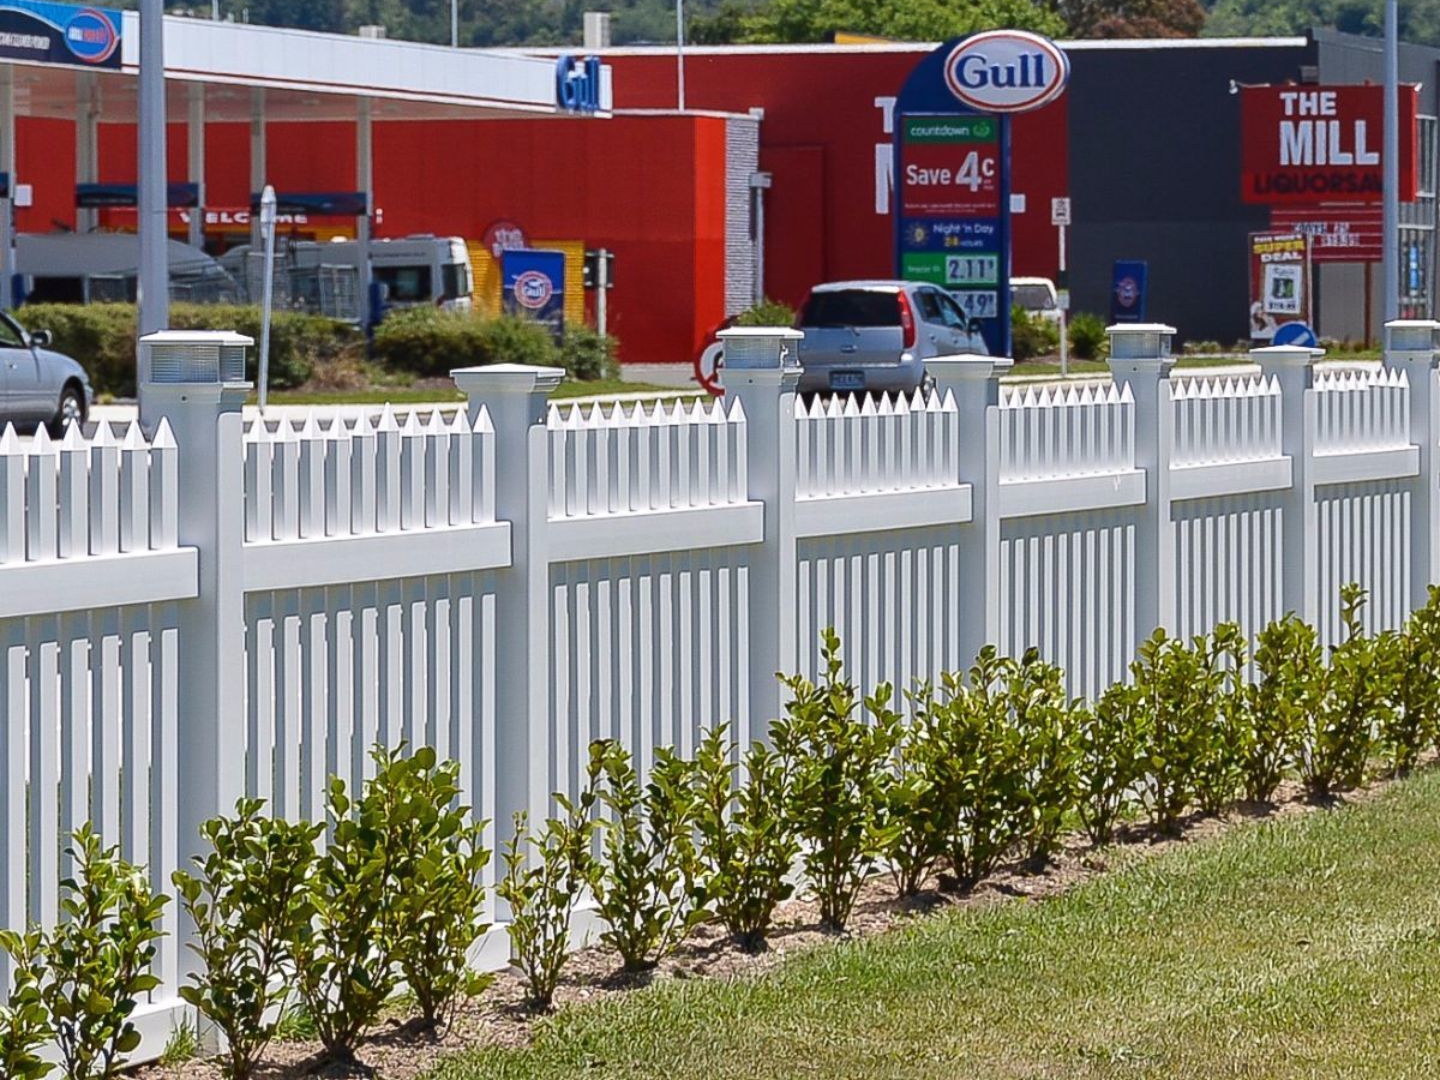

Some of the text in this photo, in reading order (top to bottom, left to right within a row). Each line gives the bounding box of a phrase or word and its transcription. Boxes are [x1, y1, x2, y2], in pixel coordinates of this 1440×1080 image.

[954, 53, 1046, 89] Gull
[1279, 91, 1338, 116] THE
[909, 124, 971, 137] countdown
[1279, 119, 1380, 166] MILL
[906, 164, 951, 186] Save
[932, 223, 961, 235] Night
[974, 223, 995, 235] Day
[1252, 239, 1306, 255] SUPER
[1260, 251, 1303, 263] DEAL
